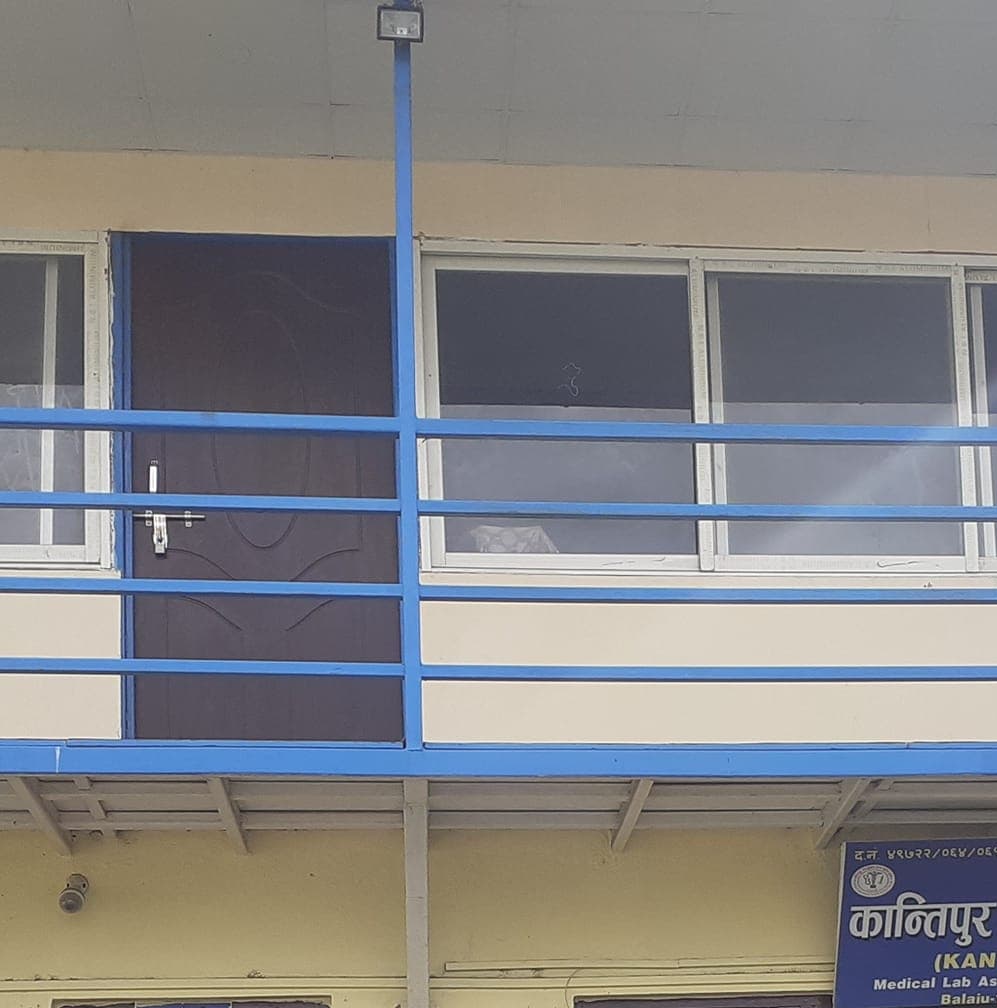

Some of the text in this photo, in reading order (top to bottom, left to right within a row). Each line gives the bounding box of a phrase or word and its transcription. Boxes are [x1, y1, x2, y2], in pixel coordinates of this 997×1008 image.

[849, 891, 997, 946] कान्तिपुर
[873, 977, 936, 991] Medical
[942, 976, 971, 988] Lab
